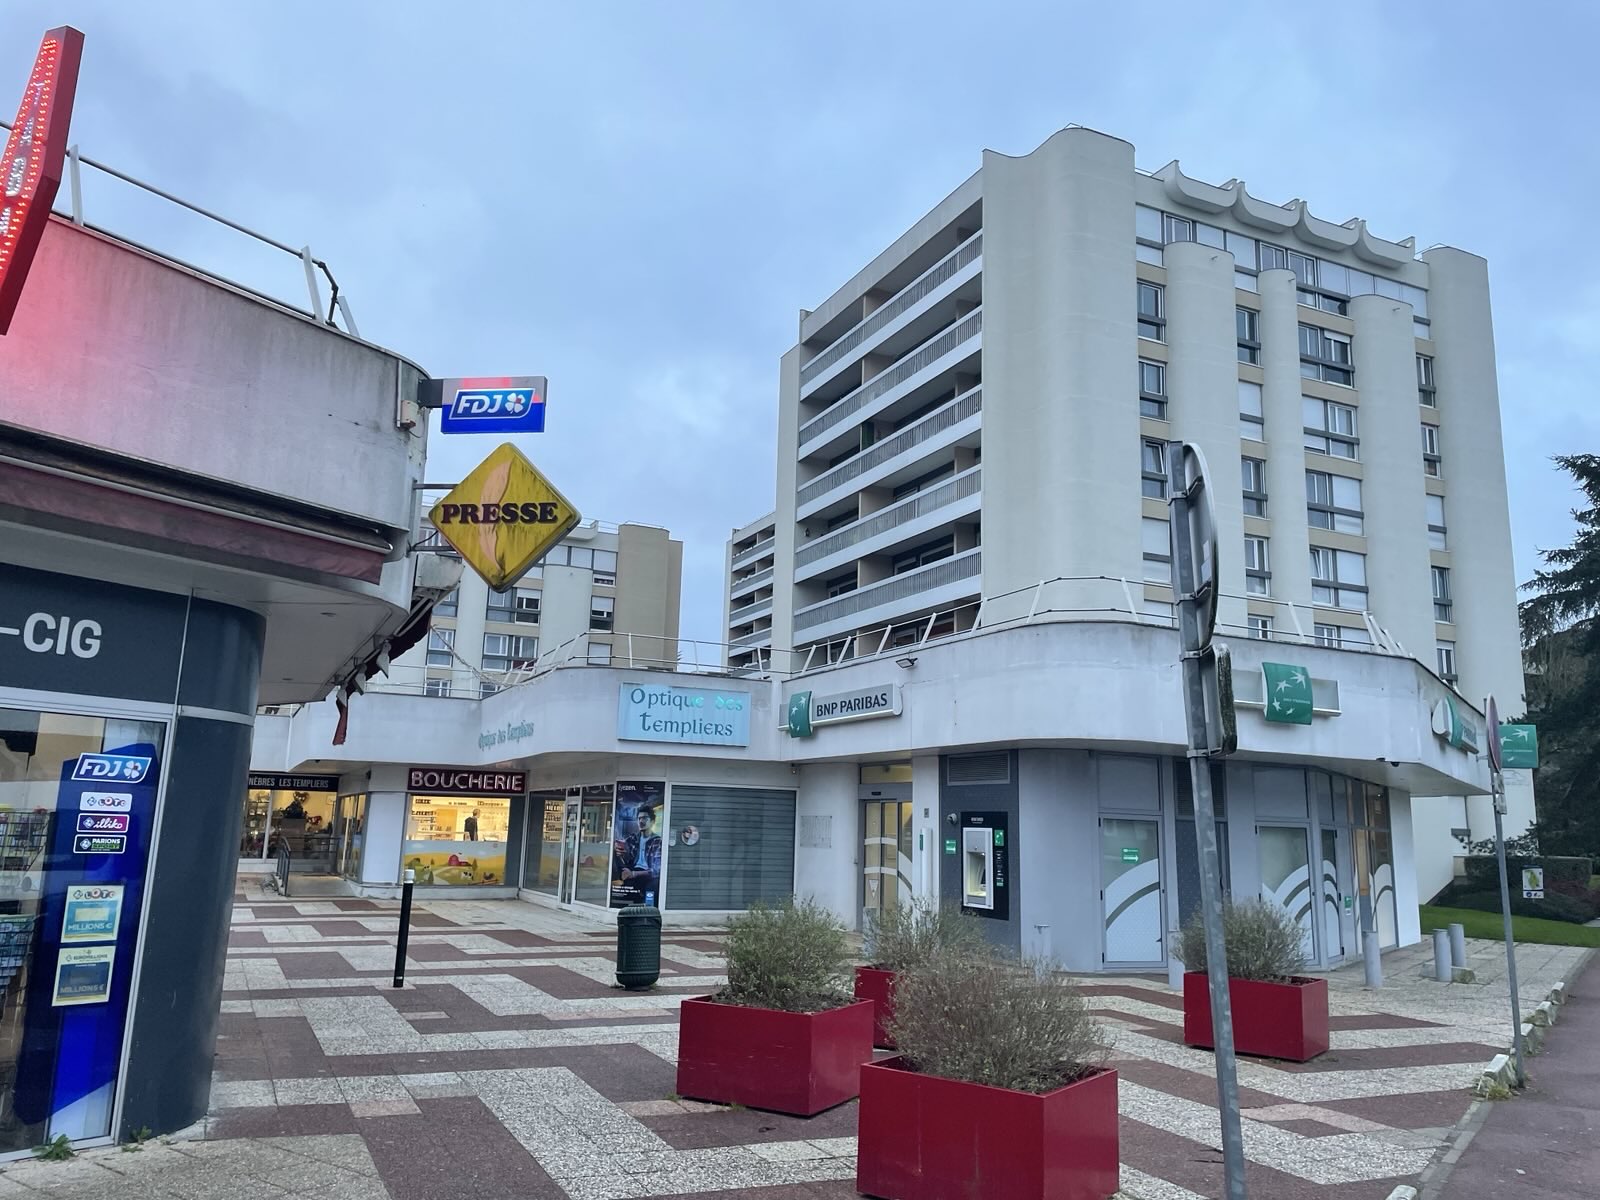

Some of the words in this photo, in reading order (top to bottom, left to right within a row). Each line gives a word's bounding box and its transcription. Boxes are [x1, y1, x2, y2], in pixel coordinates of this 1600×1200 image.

[457, 394, 503, 414] FDJ
[441, 502, 559, 525] PRESSE
[630, 687, 705, 711] Optique
[816, 702, 838, 717] BNP
[840, 692, 888, 713] PARIBAS
[79, 758, 123, 777] FDJ
[278, 778, 292, 787] LES
[293, 778, 329, 788] TEMPLIERS
[411, 770, 523, 791] BOUCHERIE
[93, 818, 123, 829] illiko
[92, 837, 121, 845] PARIONS
[68, 922, 105, 931] MILLIONS
[60, 983, 98, 993] MILLIONS
